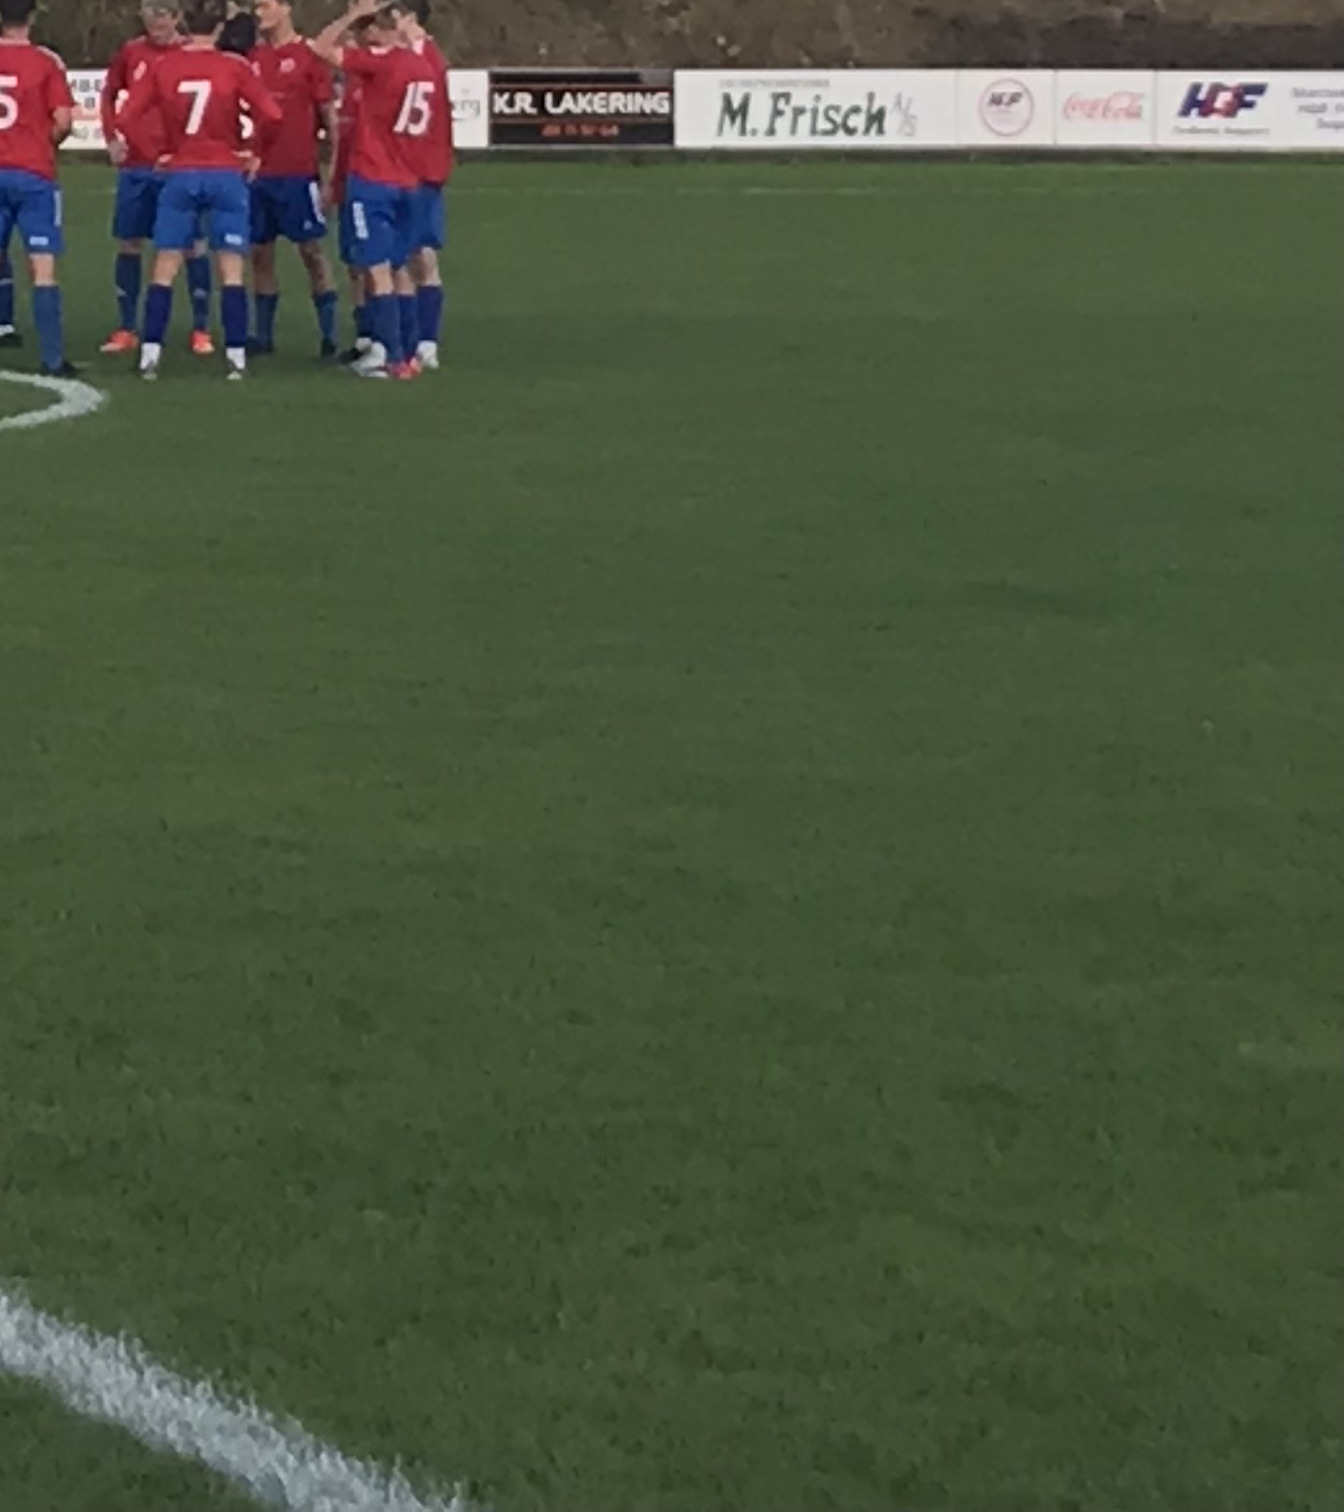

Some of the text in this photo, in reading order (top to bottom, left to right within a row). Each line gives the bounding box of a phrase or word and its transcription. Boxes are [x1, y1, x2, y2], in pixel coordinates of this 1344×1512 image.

[177, 79, 212, 135] 7
[393, 81, 435, 135] 15
[543, 91, 671, 115] LAKERING
